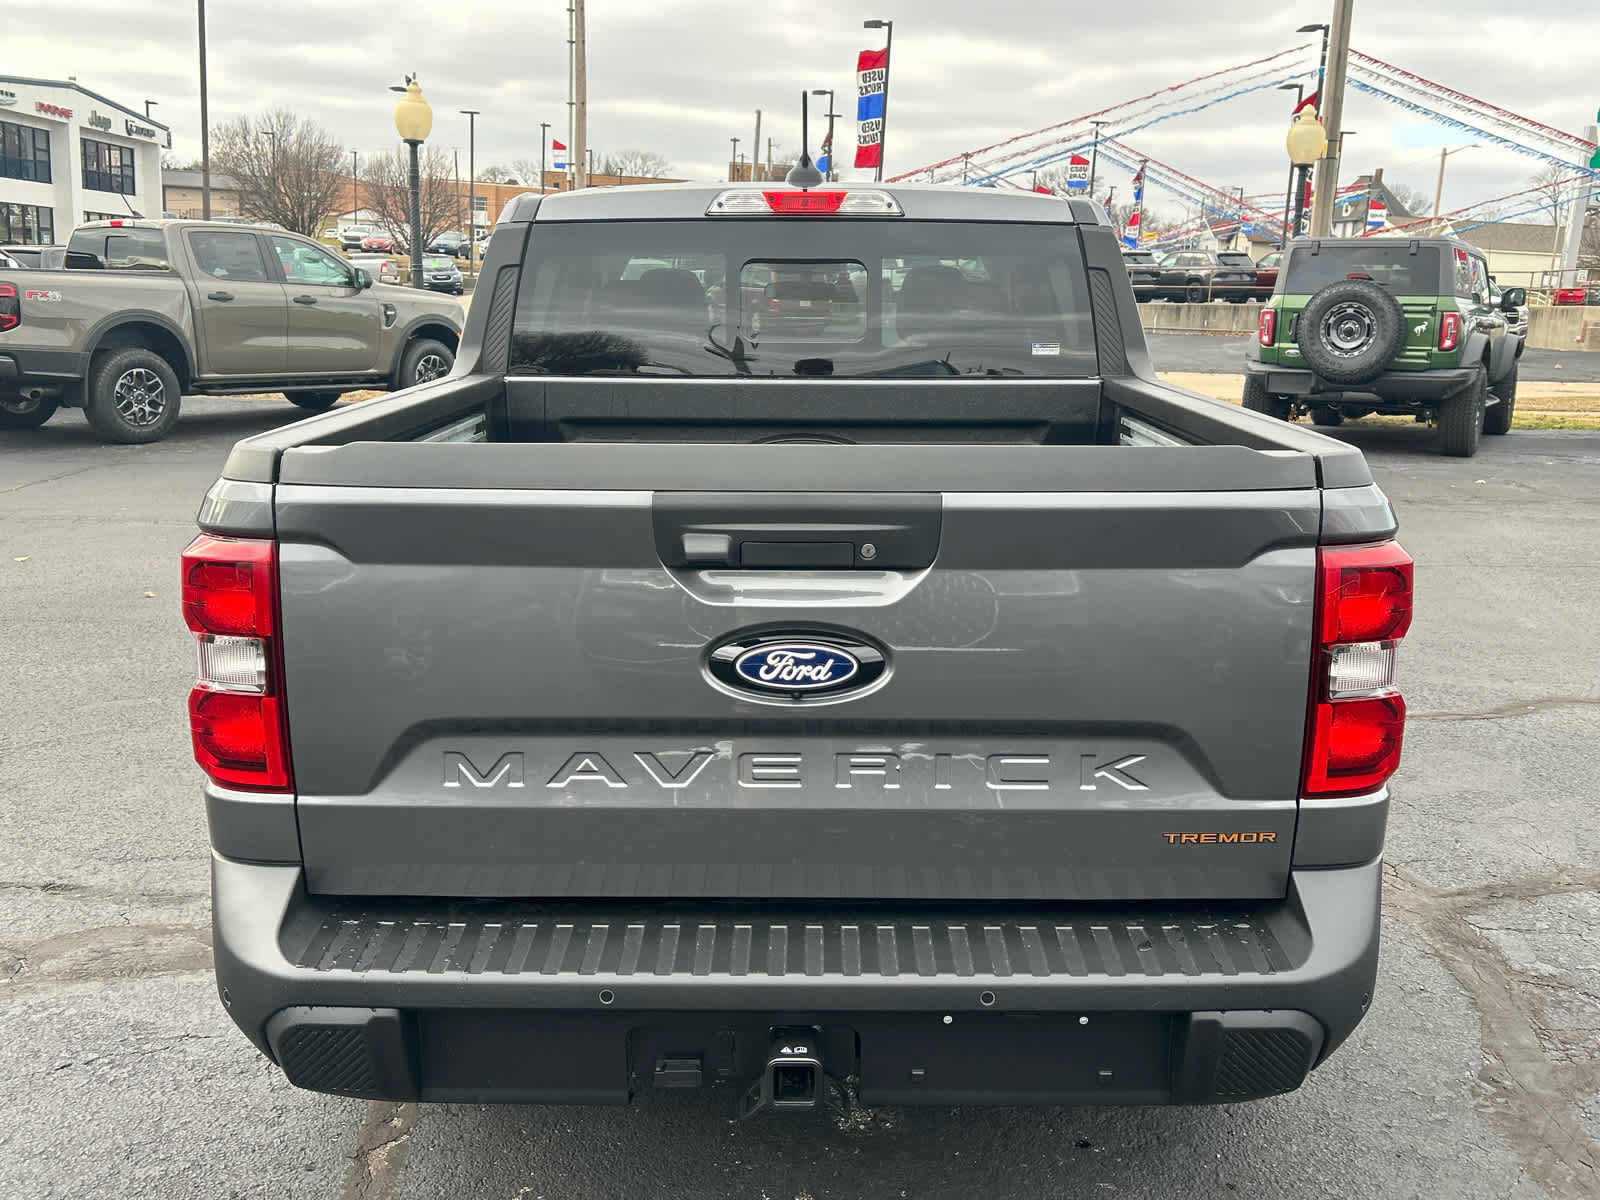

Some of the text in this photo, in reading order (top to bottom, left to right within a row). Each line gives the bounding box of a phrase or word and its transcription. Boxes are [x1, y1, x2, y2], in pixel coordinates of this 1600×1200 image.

[88, 110, 112, 131] Jeep
[759, 650, 835, 681] Ford
[442, 750, 1151, 791] MAVERICK
[1164, 832, 1278, 844] TREMOR
